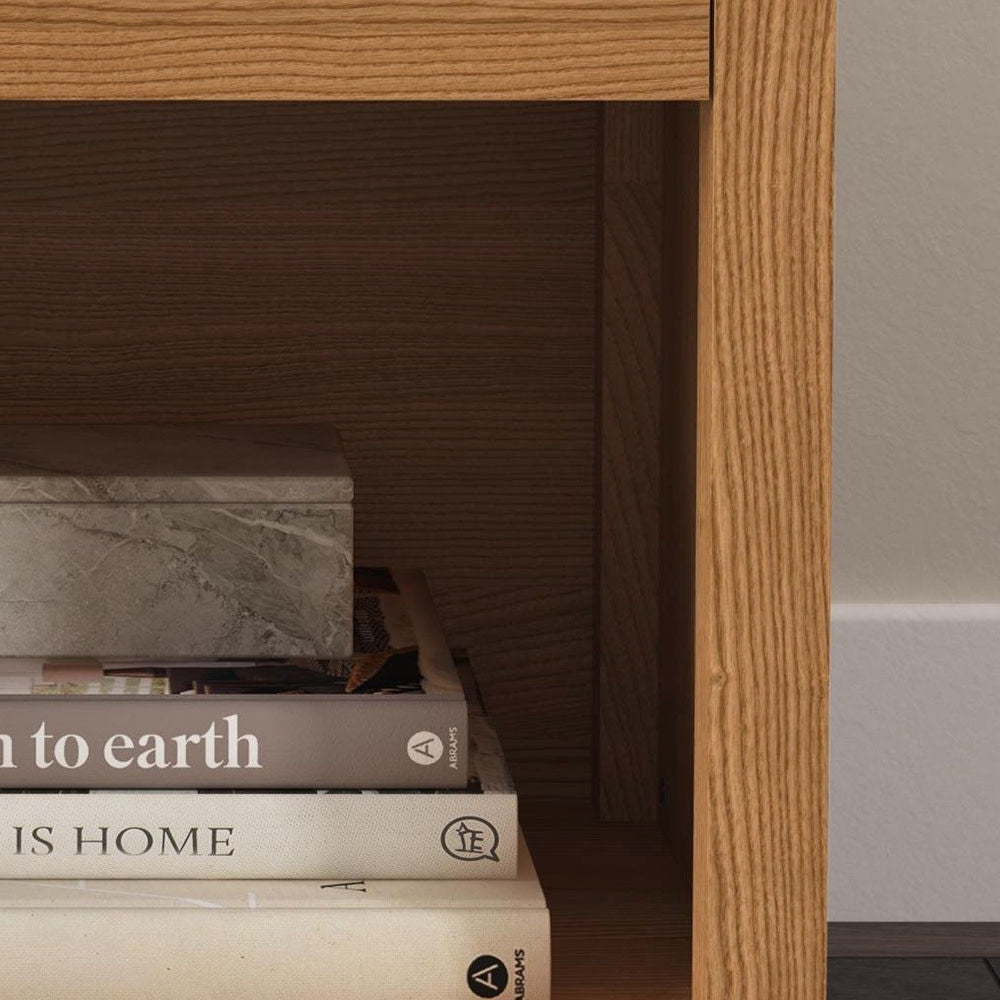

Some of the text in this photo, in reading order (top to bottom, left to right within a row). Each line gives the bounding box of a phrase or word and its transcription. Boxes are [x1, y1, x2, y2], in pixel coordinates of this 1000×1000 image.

[30, 720, 90, 770] to
[103, 713, 263, 770] earth
[449, 726, 458, 770] ABRAMS
[13, 826, 54, 855] IS
[74, 826, 235, 856] HOME
